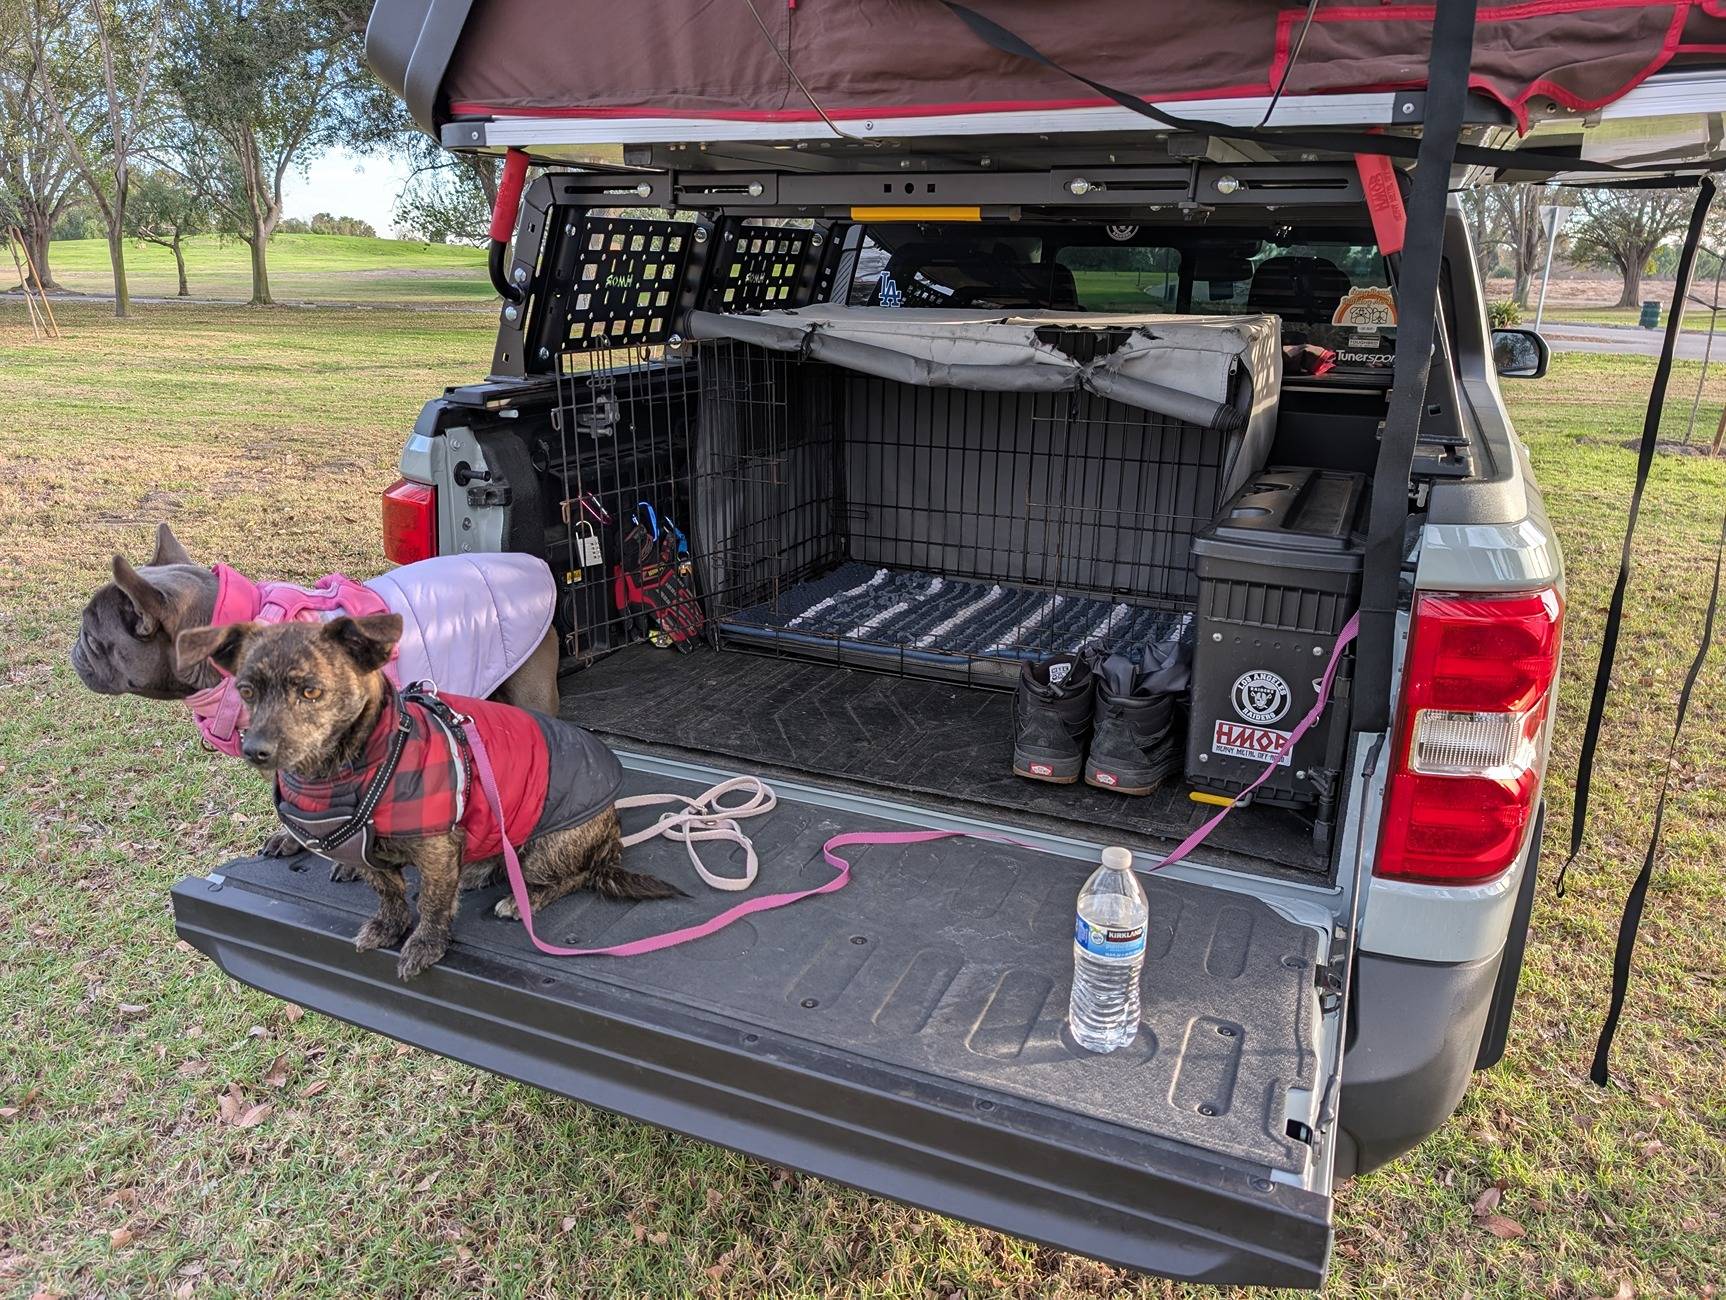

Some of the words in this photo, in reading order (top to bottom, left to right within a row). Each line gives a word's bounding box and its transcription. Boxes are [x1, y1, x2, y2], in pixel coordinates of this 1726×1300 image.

[878, 271, 902, 307] LA
[1336, 350, 1395, 364] Tunerspor
[1237, 676, 1252, 690] LOS
[1253, 673, 1287, 696] ANGELES
[1250, 686, 1274, 694] RAIDERS
[1242, 708, 1275, 720] RAIDERS
[1216, 722, 1290, 756] HMOR
[1108, 928, 1142, 938] KIRKLAND
